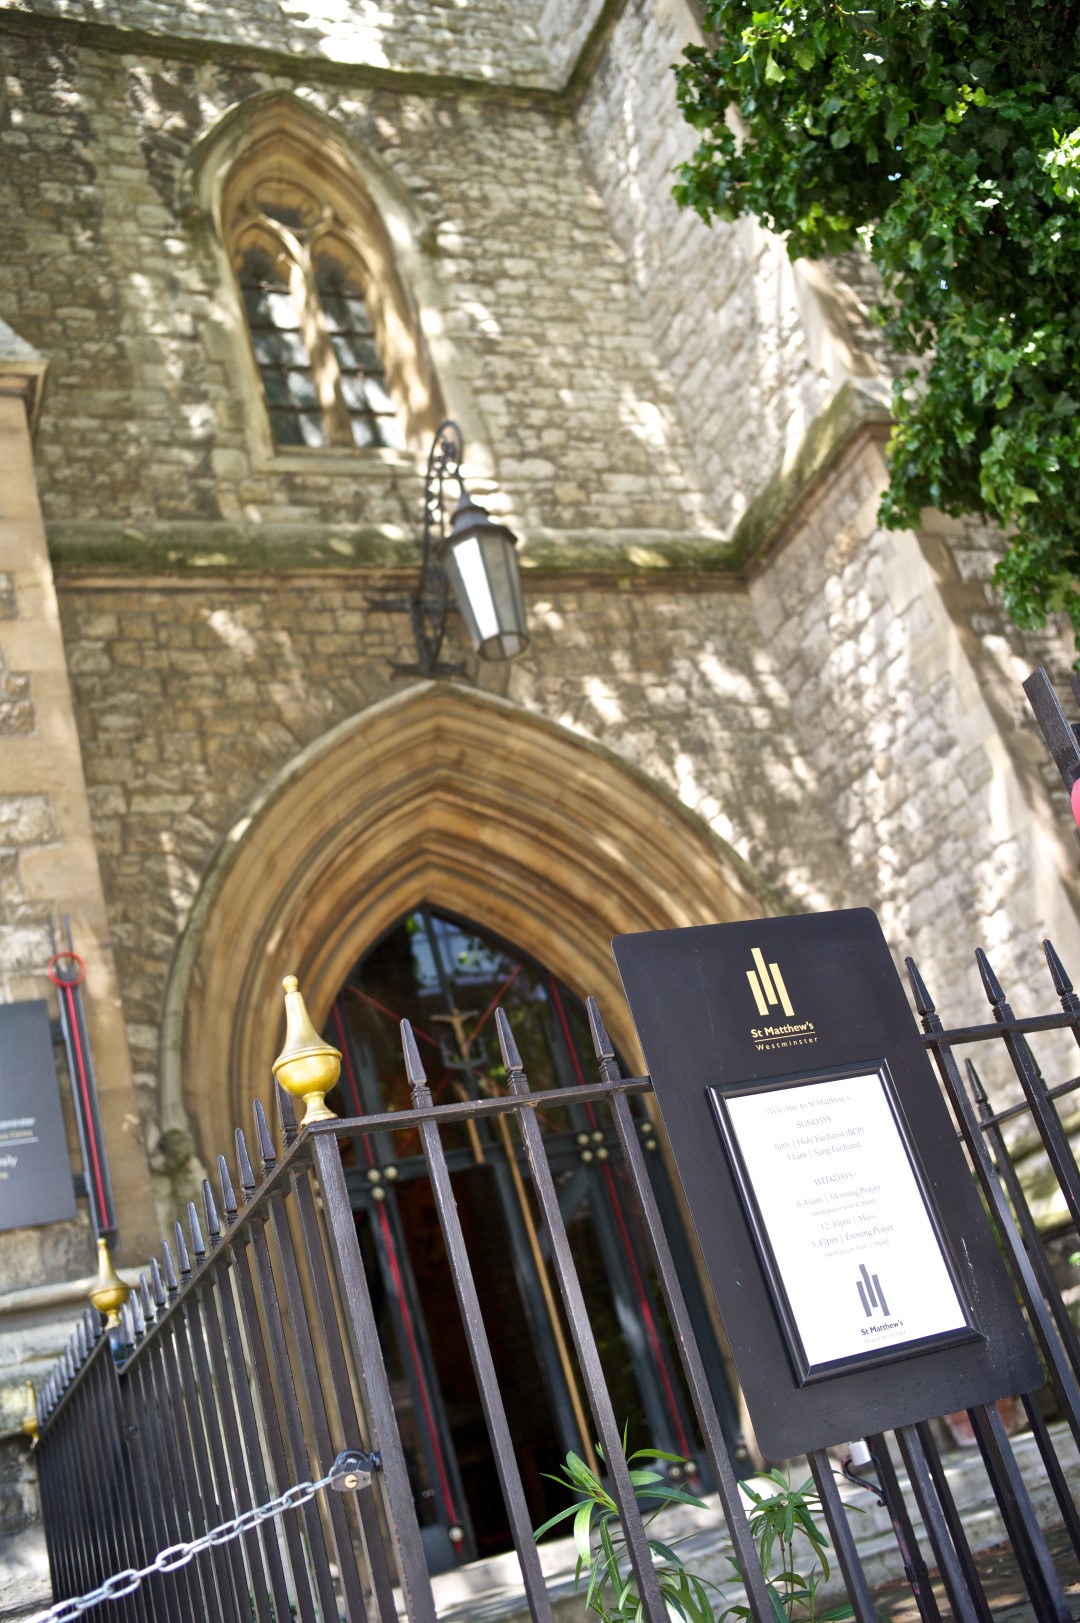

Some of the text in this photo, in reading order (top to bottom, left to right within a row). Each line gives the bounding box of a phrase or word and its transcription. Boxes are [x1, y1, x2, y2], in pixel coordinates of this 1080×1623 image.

[750, 1021, 815, 1038] St Matthew's
[755, 1037, 818, 1051] Westminster
[765, 1104, 799, 1115] Welcome
[807, 1100, 815, 1108] St
[796, 1115, 832, 1128] SUNDAYS
[774, 1142, 790, 1151] 8am
[796, 1136, 814, 1146] Holy
[814, 1130, 845, 1143] Eucharist
[845, 1126, 866, 1138] (BCP)
[813, 1147, 832, 1157] Sung
[831, 1141, 862, 1153] Eucharist
[813, 1171, 855, 1186] WEEKDAYS
[796, 1196, 823, 1208] 8.45am
[830, 1188, 860, 1201] Morning
[859, 1184, 882, 1195] Prayer
[820, 1218, 852, 1231] 12.30pm
[857, 1213, 876, 1223] Mass
[811, 1236, 839, 1249] 5.45pm
[845, 1229, 874, 1241] Evening
[872, 1224, 894, 1235] Prayer
[860, 1319, 904, 1336] St Matthew's
